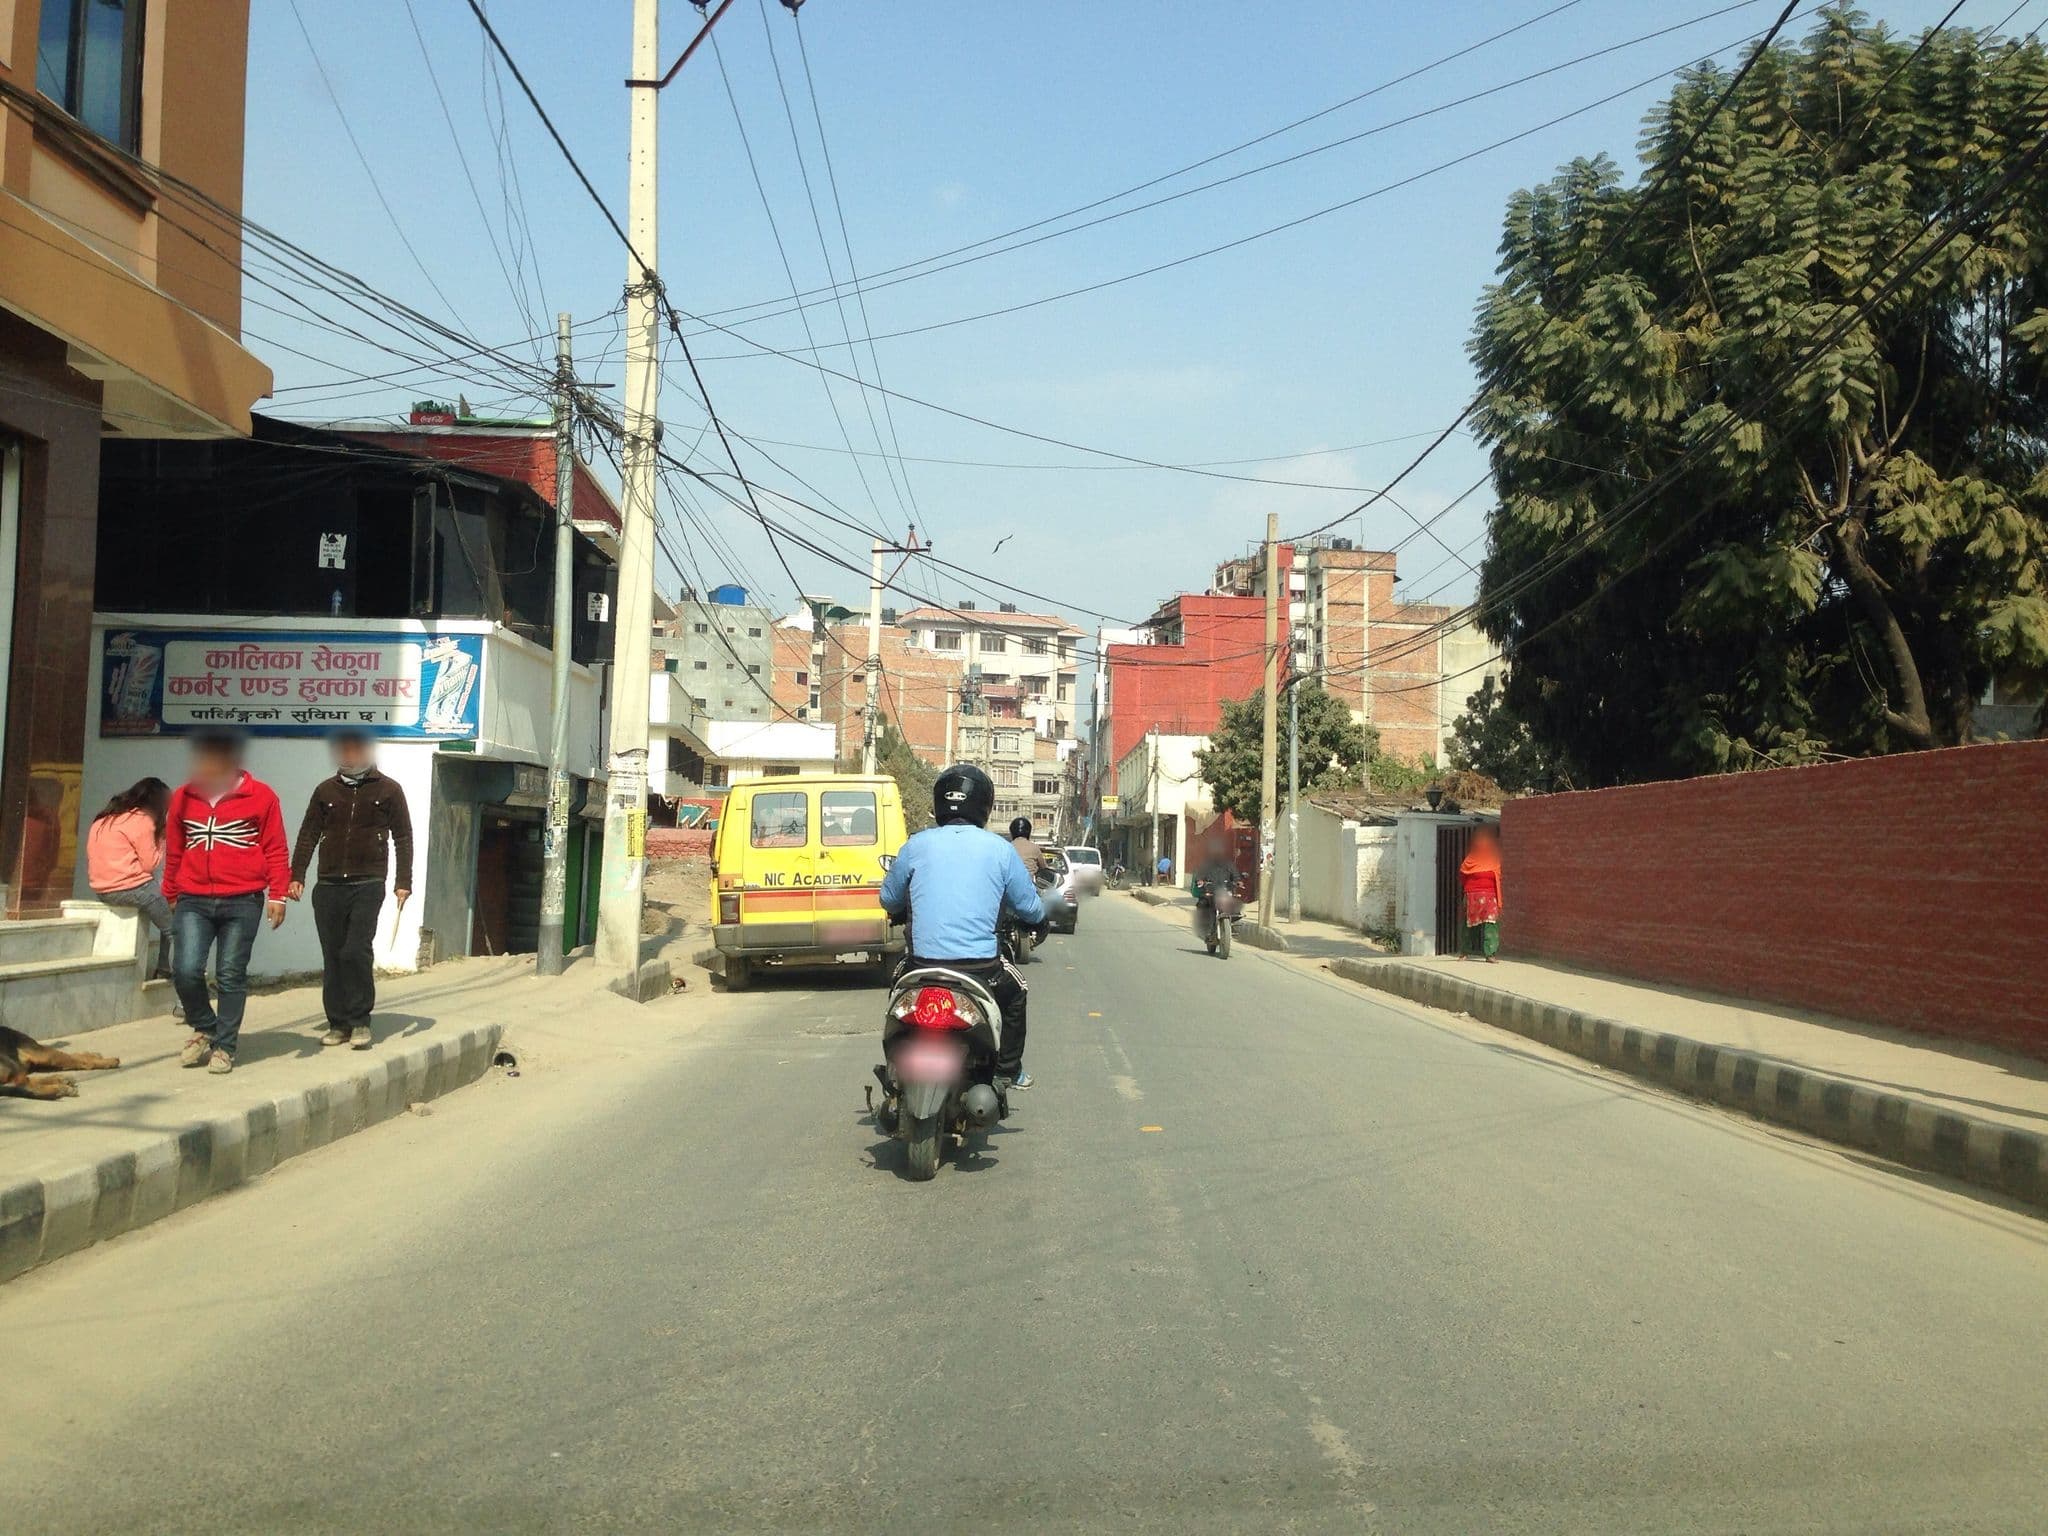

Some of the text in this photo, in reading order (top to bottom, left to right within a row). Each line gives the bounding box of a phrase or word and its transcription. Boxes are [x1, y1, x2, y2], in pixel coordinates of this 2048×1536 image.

[205, 643, 382, 676] कालिका सेकुवा
[168, 672, 232, 698] कर्नर
[240, 677, 291, 697] एण्ड
[298, 678, 368, 703] हुक्का
[372, 678, 416, 699] बार
[291, 707, 350, 723] सुविधा
[764, 872, 786, 887] NIC
[793, 872, 863, 886] ACADEMY
